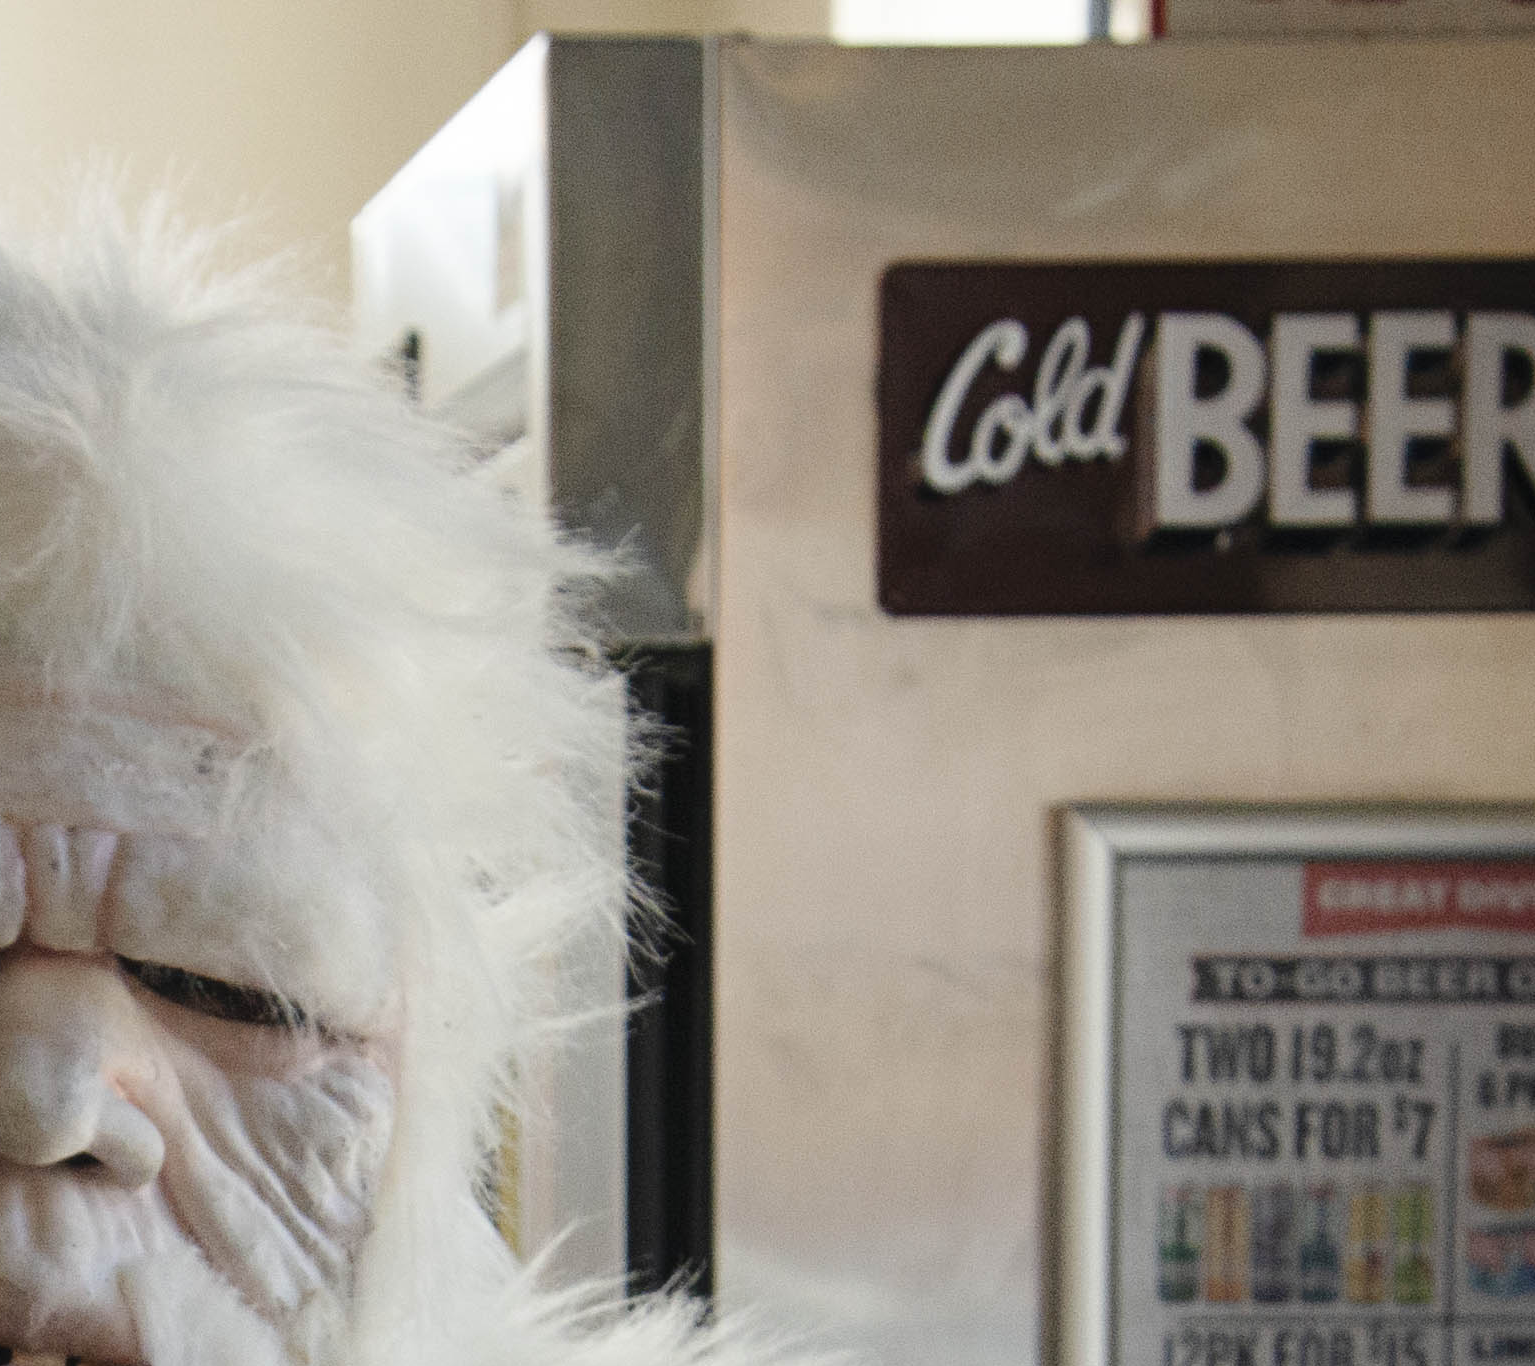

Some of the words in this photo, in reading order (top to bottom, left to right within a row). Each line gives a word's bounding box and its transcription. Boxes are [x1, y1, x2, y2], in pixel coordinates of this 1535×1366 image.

[920, 314, 1144, 492] Cold
[1317, 878, 1445, 912] GREAT
[1374, 961, 1495, 998] BEER
[1178, 1025, 1274, 1082] TWO
[1163, 1100, 1280, 1159] CANS
[1296, 1101, 1378, 1158] FOR
[1394, 1096, 1435, 1158] $7
